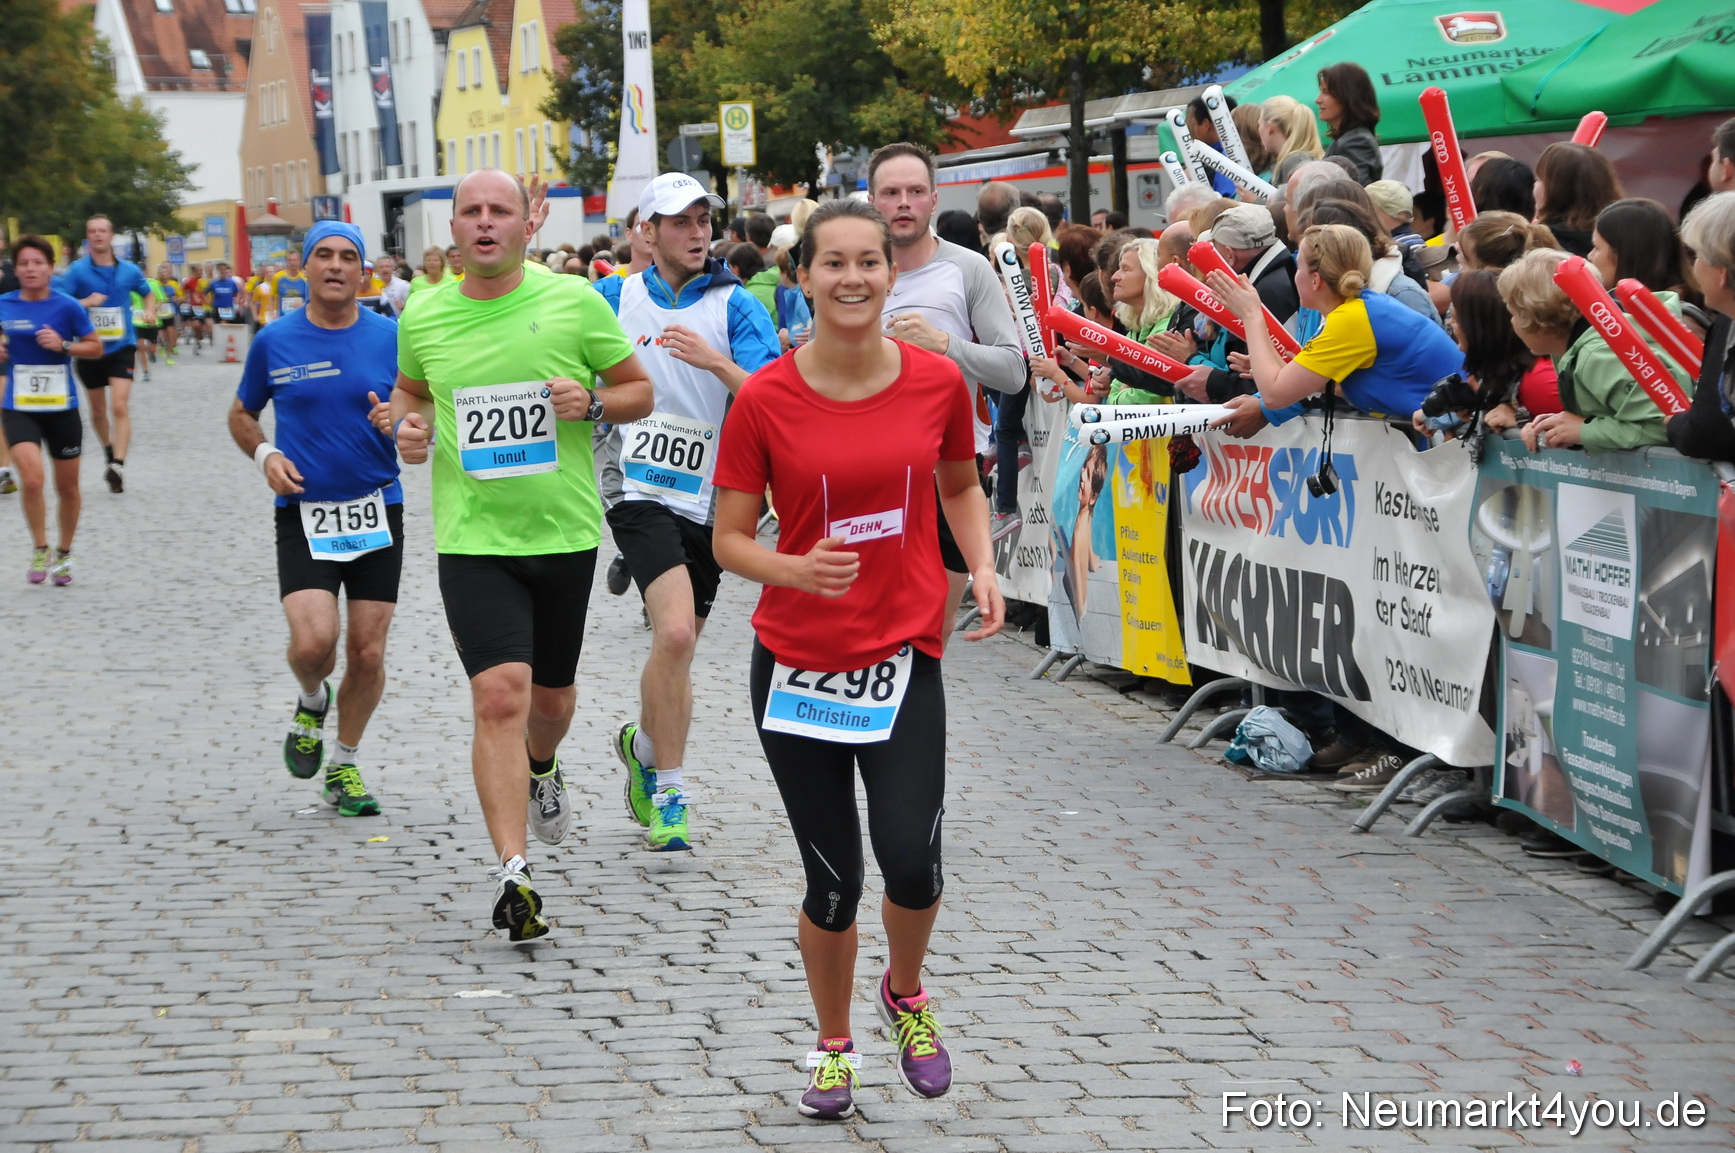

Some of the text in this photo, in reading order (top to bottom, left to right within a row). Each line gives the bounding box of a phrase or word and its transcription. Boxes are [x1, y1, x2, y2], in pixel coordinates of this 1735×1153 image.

[1407, 46, 1560, 68] Neumarkte
[1444, 174, 1467, 229] udi BKK
[1010, 274, 1032, 311] BMW
[94, 315, 116, 328] 304
[1116, 342, 1173, 373] Audi BKK
[30, 376, 50, 393] 97
[1625, 345, 1688, 414] Audi BKK
[456, 391, 537, 407] PARTL Neumarkt
[466, 403, 547, 444] 2202
[660, 421, 702, 437] Neumarkt
[1122, 424, 1167, 442] BMW
[493, 449, 527, 464] Ionut
[631, 431, 705, 471] 2060
[645, 469, 677, 488] Georg
[311, 501, 379, 534] 2159
[850, 520, 883, 536] DEHN
[331, 538, 368, 551] Robert
[1372, 546, 1389, 582] Im
[1594, 561, 1632, 588] HOFFER
[1400, 596, 1434, 638] Stadt
[796, 701, 871, 728] Christine
